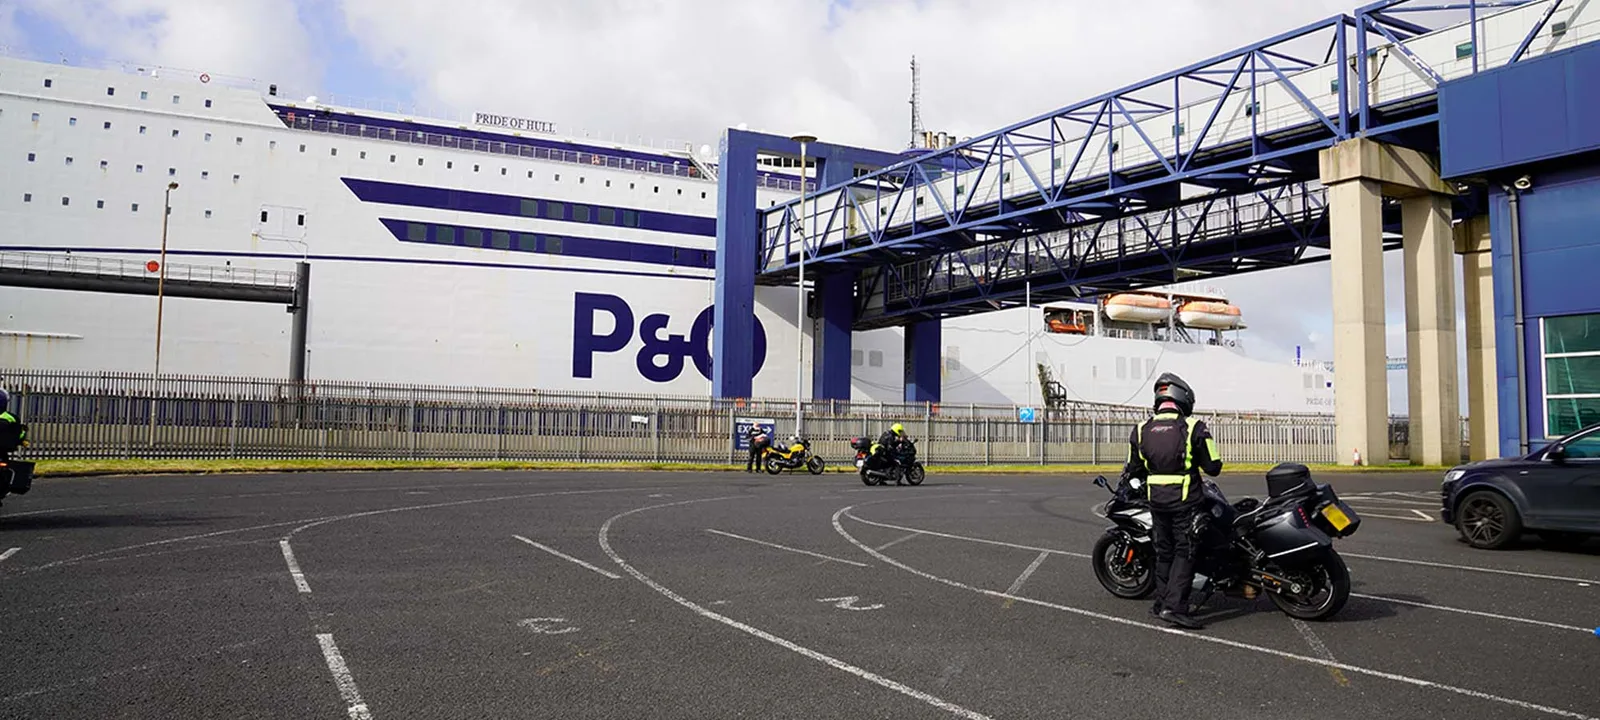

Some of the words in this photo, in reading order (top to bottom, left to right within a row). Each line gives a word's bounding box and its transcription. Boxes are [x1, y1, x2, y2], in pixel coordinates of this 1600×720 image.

[475, 112, 508, 127] PRIDE
[509, 117, 525, 129] OF
[526, 119, 557, 133] HULL
